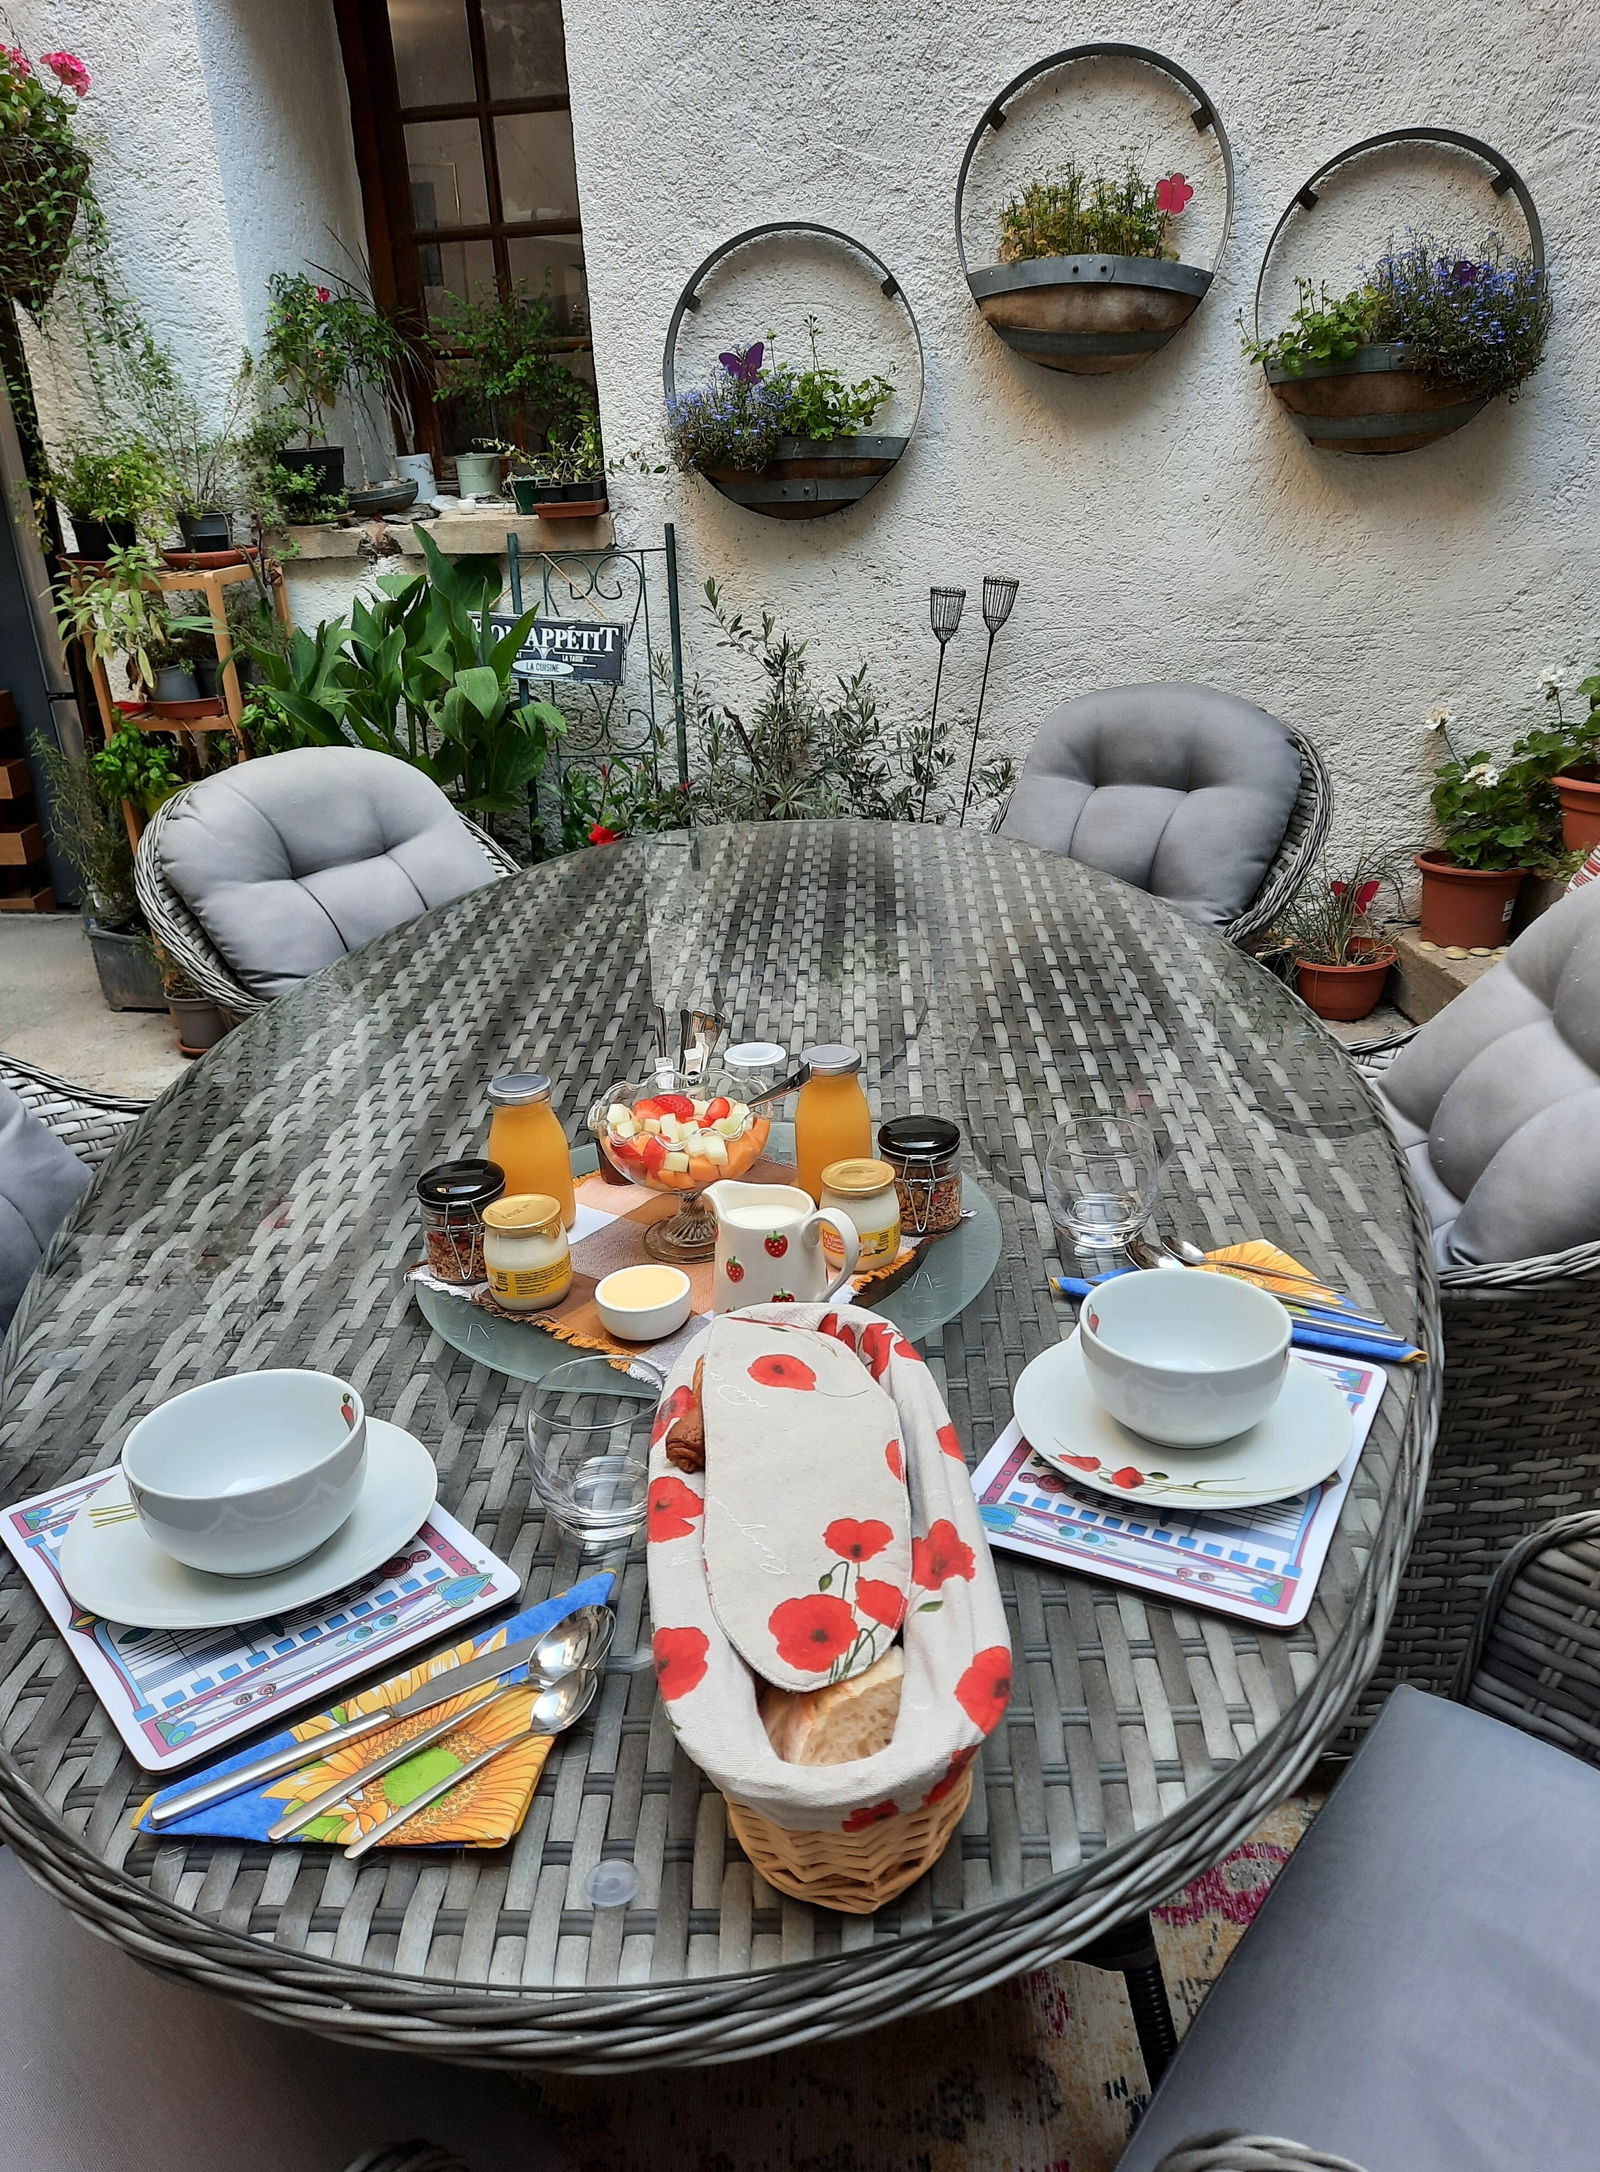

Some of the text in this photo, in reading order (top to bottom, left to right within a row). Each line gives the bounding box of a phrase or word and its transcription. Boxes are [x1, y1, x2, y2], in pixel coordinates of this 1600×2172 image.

[525, 625, 619, 652] APPÉTIT
[562, 654, 569, 662] LA
[526, 662, 561, 673] LA CUISINE
